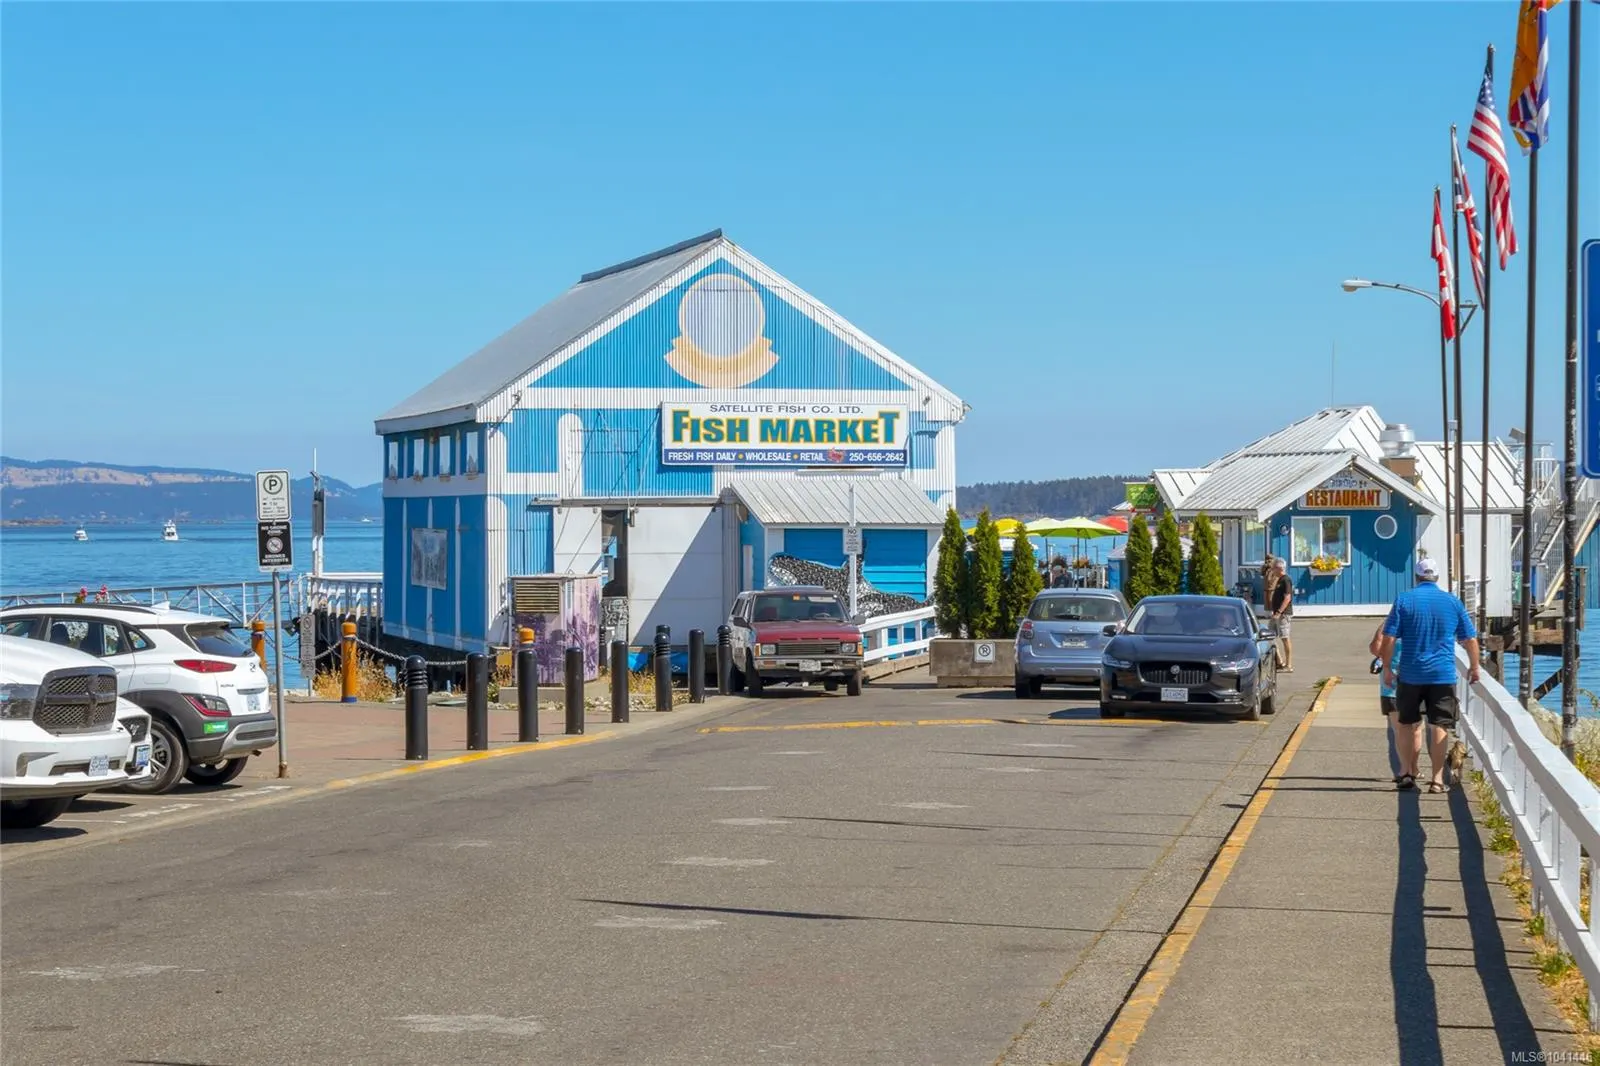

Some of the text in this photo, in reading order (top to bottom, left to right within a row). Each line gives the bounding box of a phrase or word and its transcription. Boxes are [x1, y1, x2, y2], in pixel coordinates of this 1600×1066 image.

[710, 404, 863, 414] SATELLITE FISH CO. LTD.
[668, 452, 905, 462] FRESH FISH DAILY WHOLESALE RETAIL 250-656-2642
[269, 479, 277, 490] P
[1306, 490, 1381, 506] RESTAURANT
